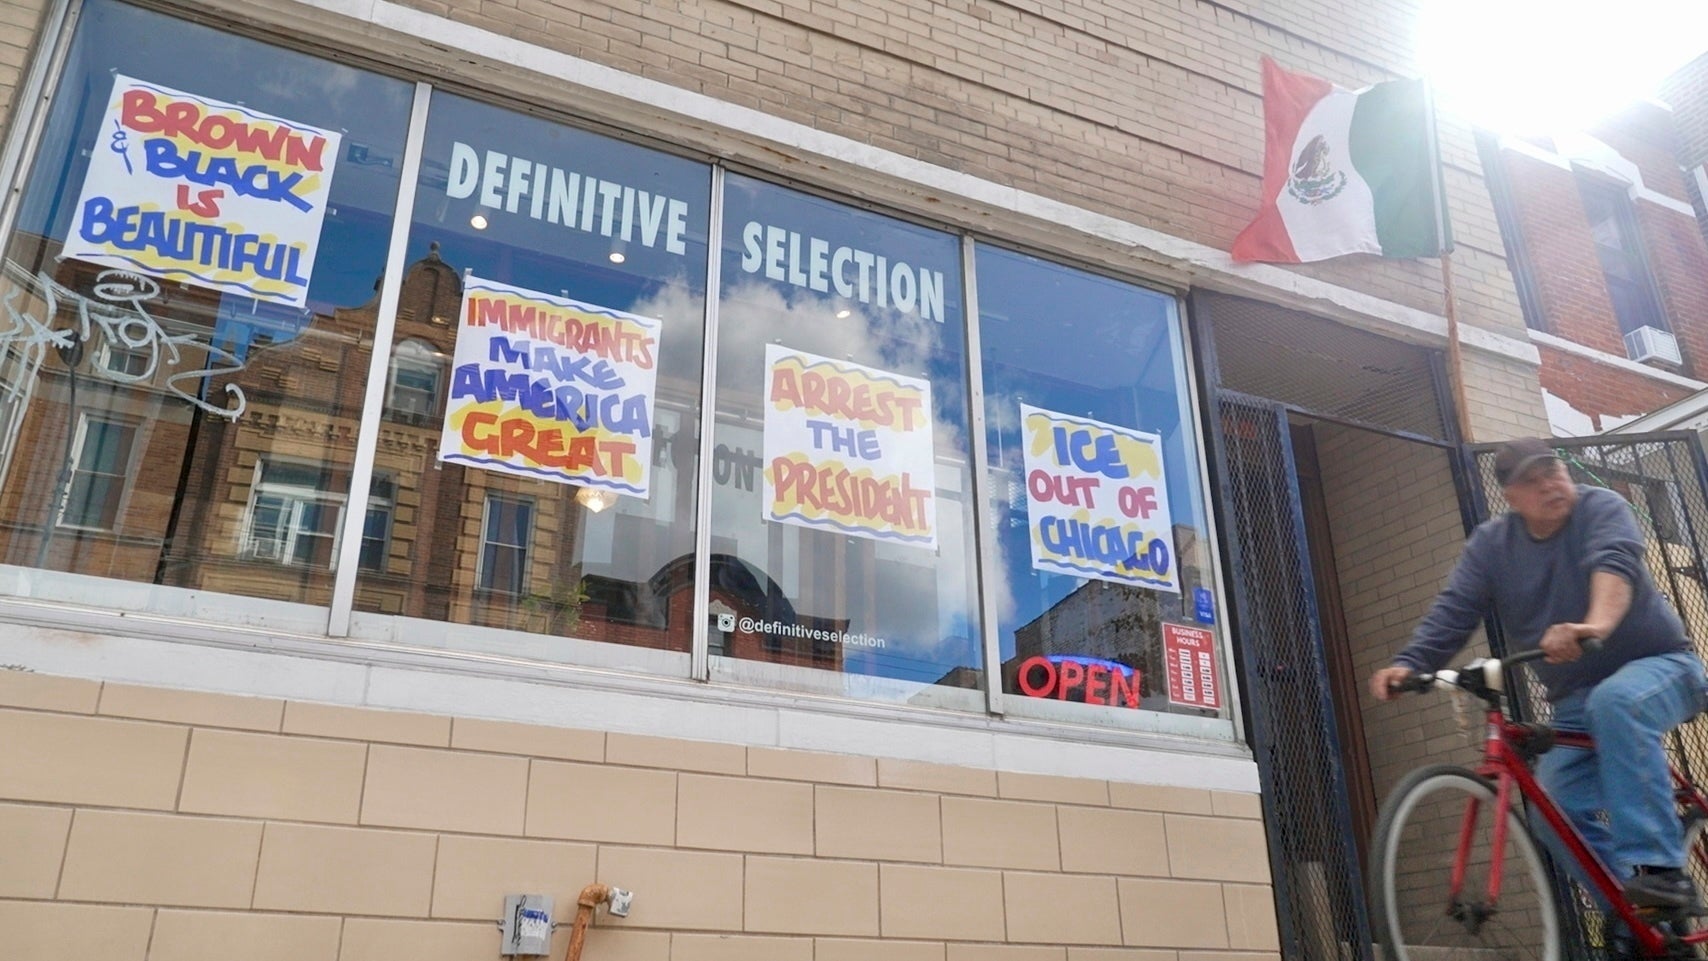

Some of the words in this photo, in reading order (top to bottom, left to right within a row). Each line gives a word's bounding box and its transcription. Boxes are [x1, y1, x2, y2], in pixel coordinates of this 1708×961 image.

[121, 90, 326, 171] BROWN
[110, 119, 133, 175] &
[143, 138, 314, 213] BLACK
[176, 184, 224, 218] IS
[446, 141, 689, 256] DEFINITIVE
[79, 196, 308, 287] BEAUTIFUL
[741, 221, 945, 323] SELECTION
[467, 297, 655, 370] IMMIGRANTS
[489, 336, 626, 390] MAKE
[451, 363, 651, 438] AMERICA
[770, 368, 922, 432] ARREST
[461, 411, 637, 478] GREAT
[806, 420, 882, 460] THE
[1052, 426, 1129, 479] ICE
[771, 456, 932, 530] PRESIDENT
[1028, 469, 1100, 509] OUT
[1118, 486, 1158, 519] OF
[1039, 515, 1170, 576] CHICAGO
[738, 616, 886, 649] @definitiveselection
[1171, 626, 1204, 640] BUSINESS
[1176, 636, 1200, 647] HOURS
[1018, 655, 1141, 709] OPEN
